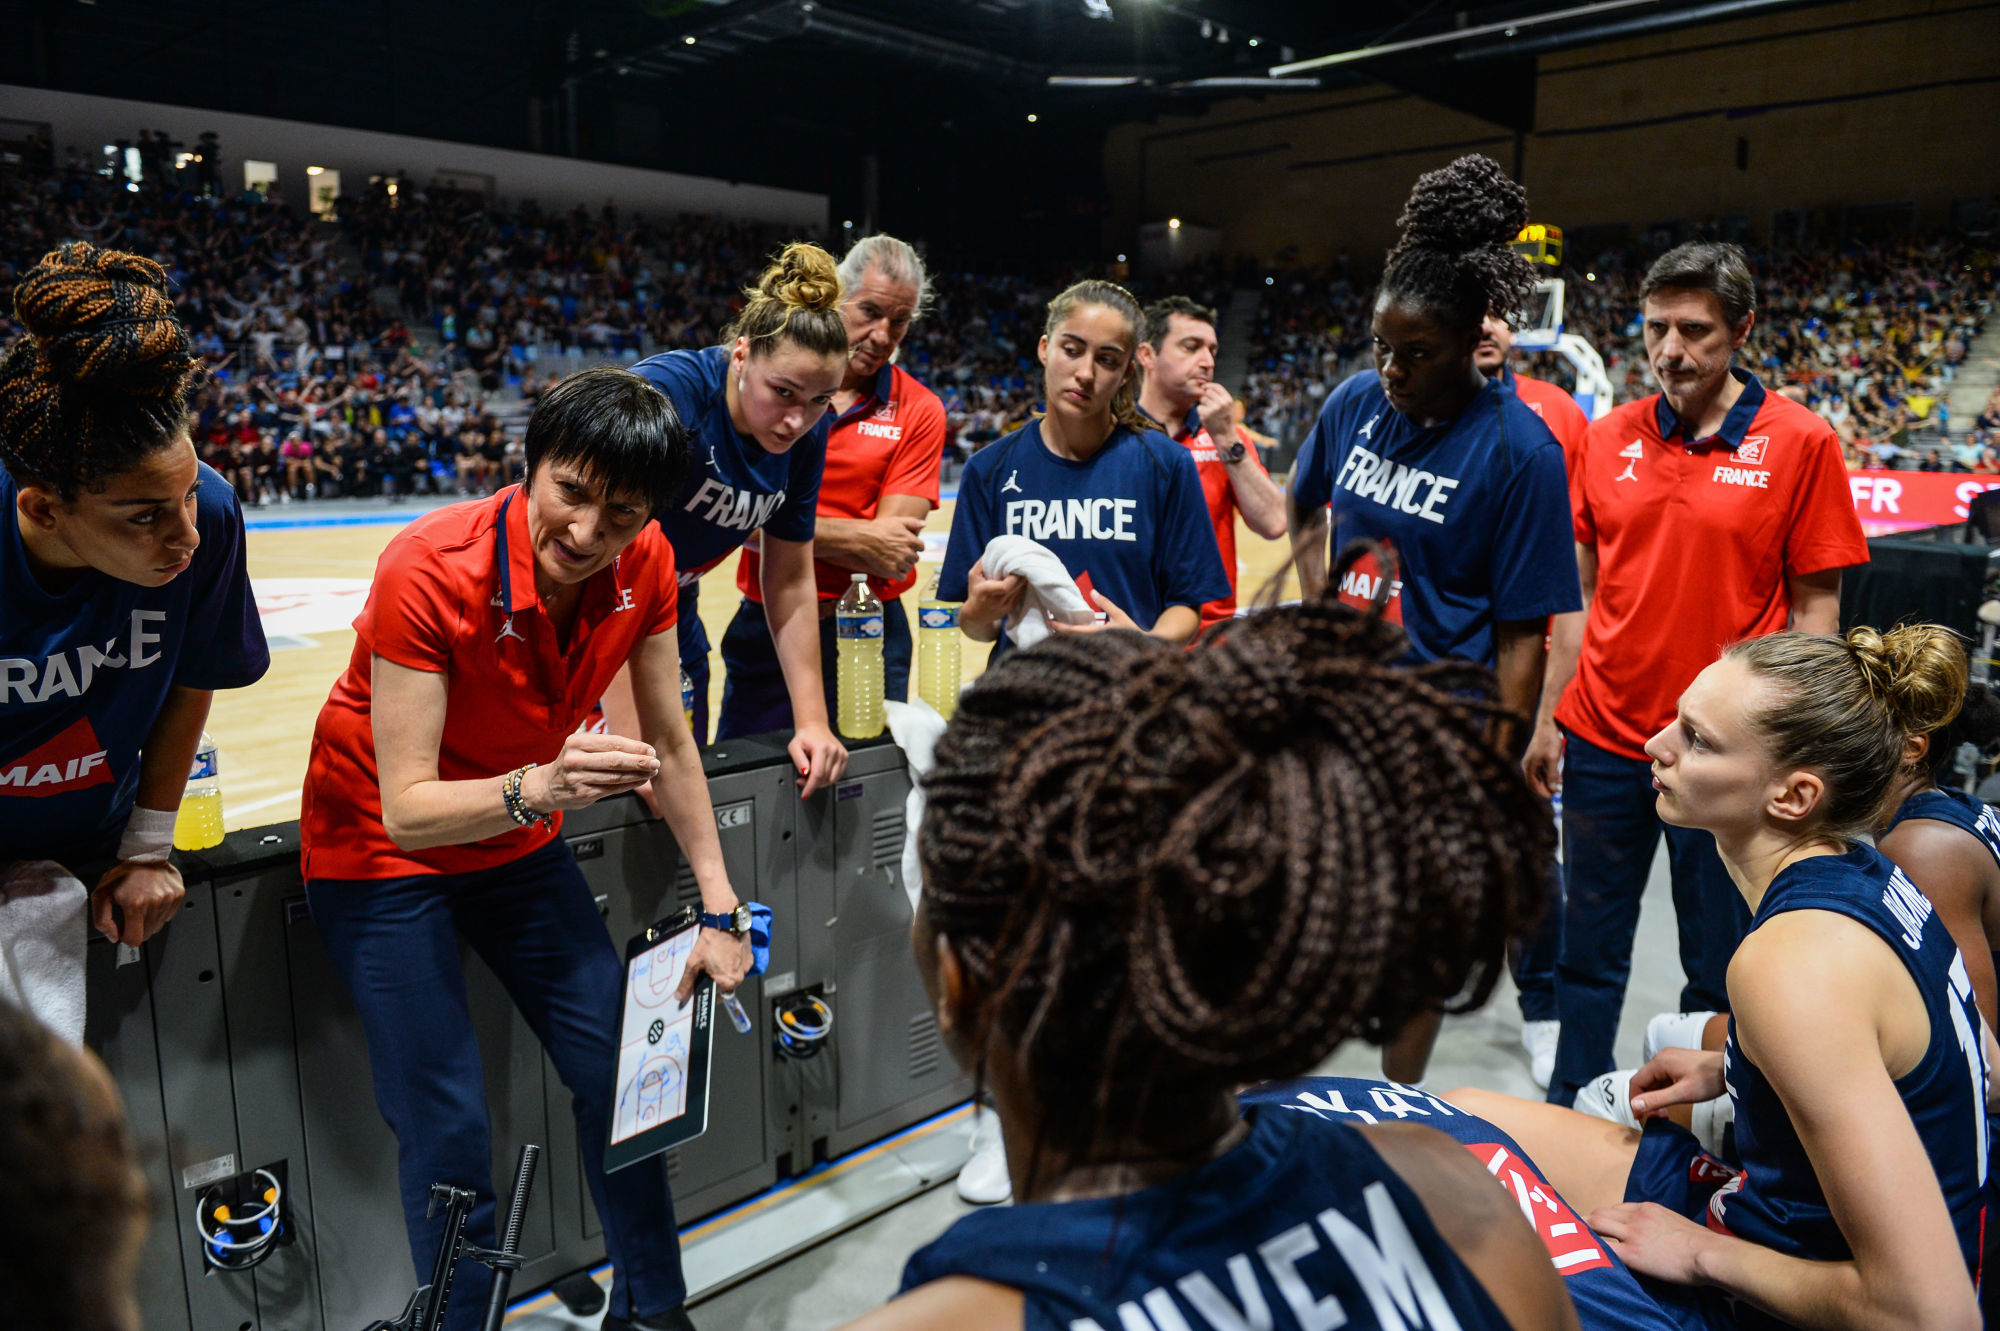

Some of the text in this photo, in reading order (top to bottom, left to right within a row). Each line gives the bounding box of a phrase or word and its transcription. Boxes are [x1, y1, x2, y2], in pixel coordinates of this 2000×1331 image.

[857, 421, 903, 440] FRANCE
[1335, 445, 1460, 525] FRANCE
[1712, 466, 1771, 488] FRANCE
[1006, 498, 1137, 541] FRANCE
[698, 987, 710, 1030] FRANCE
